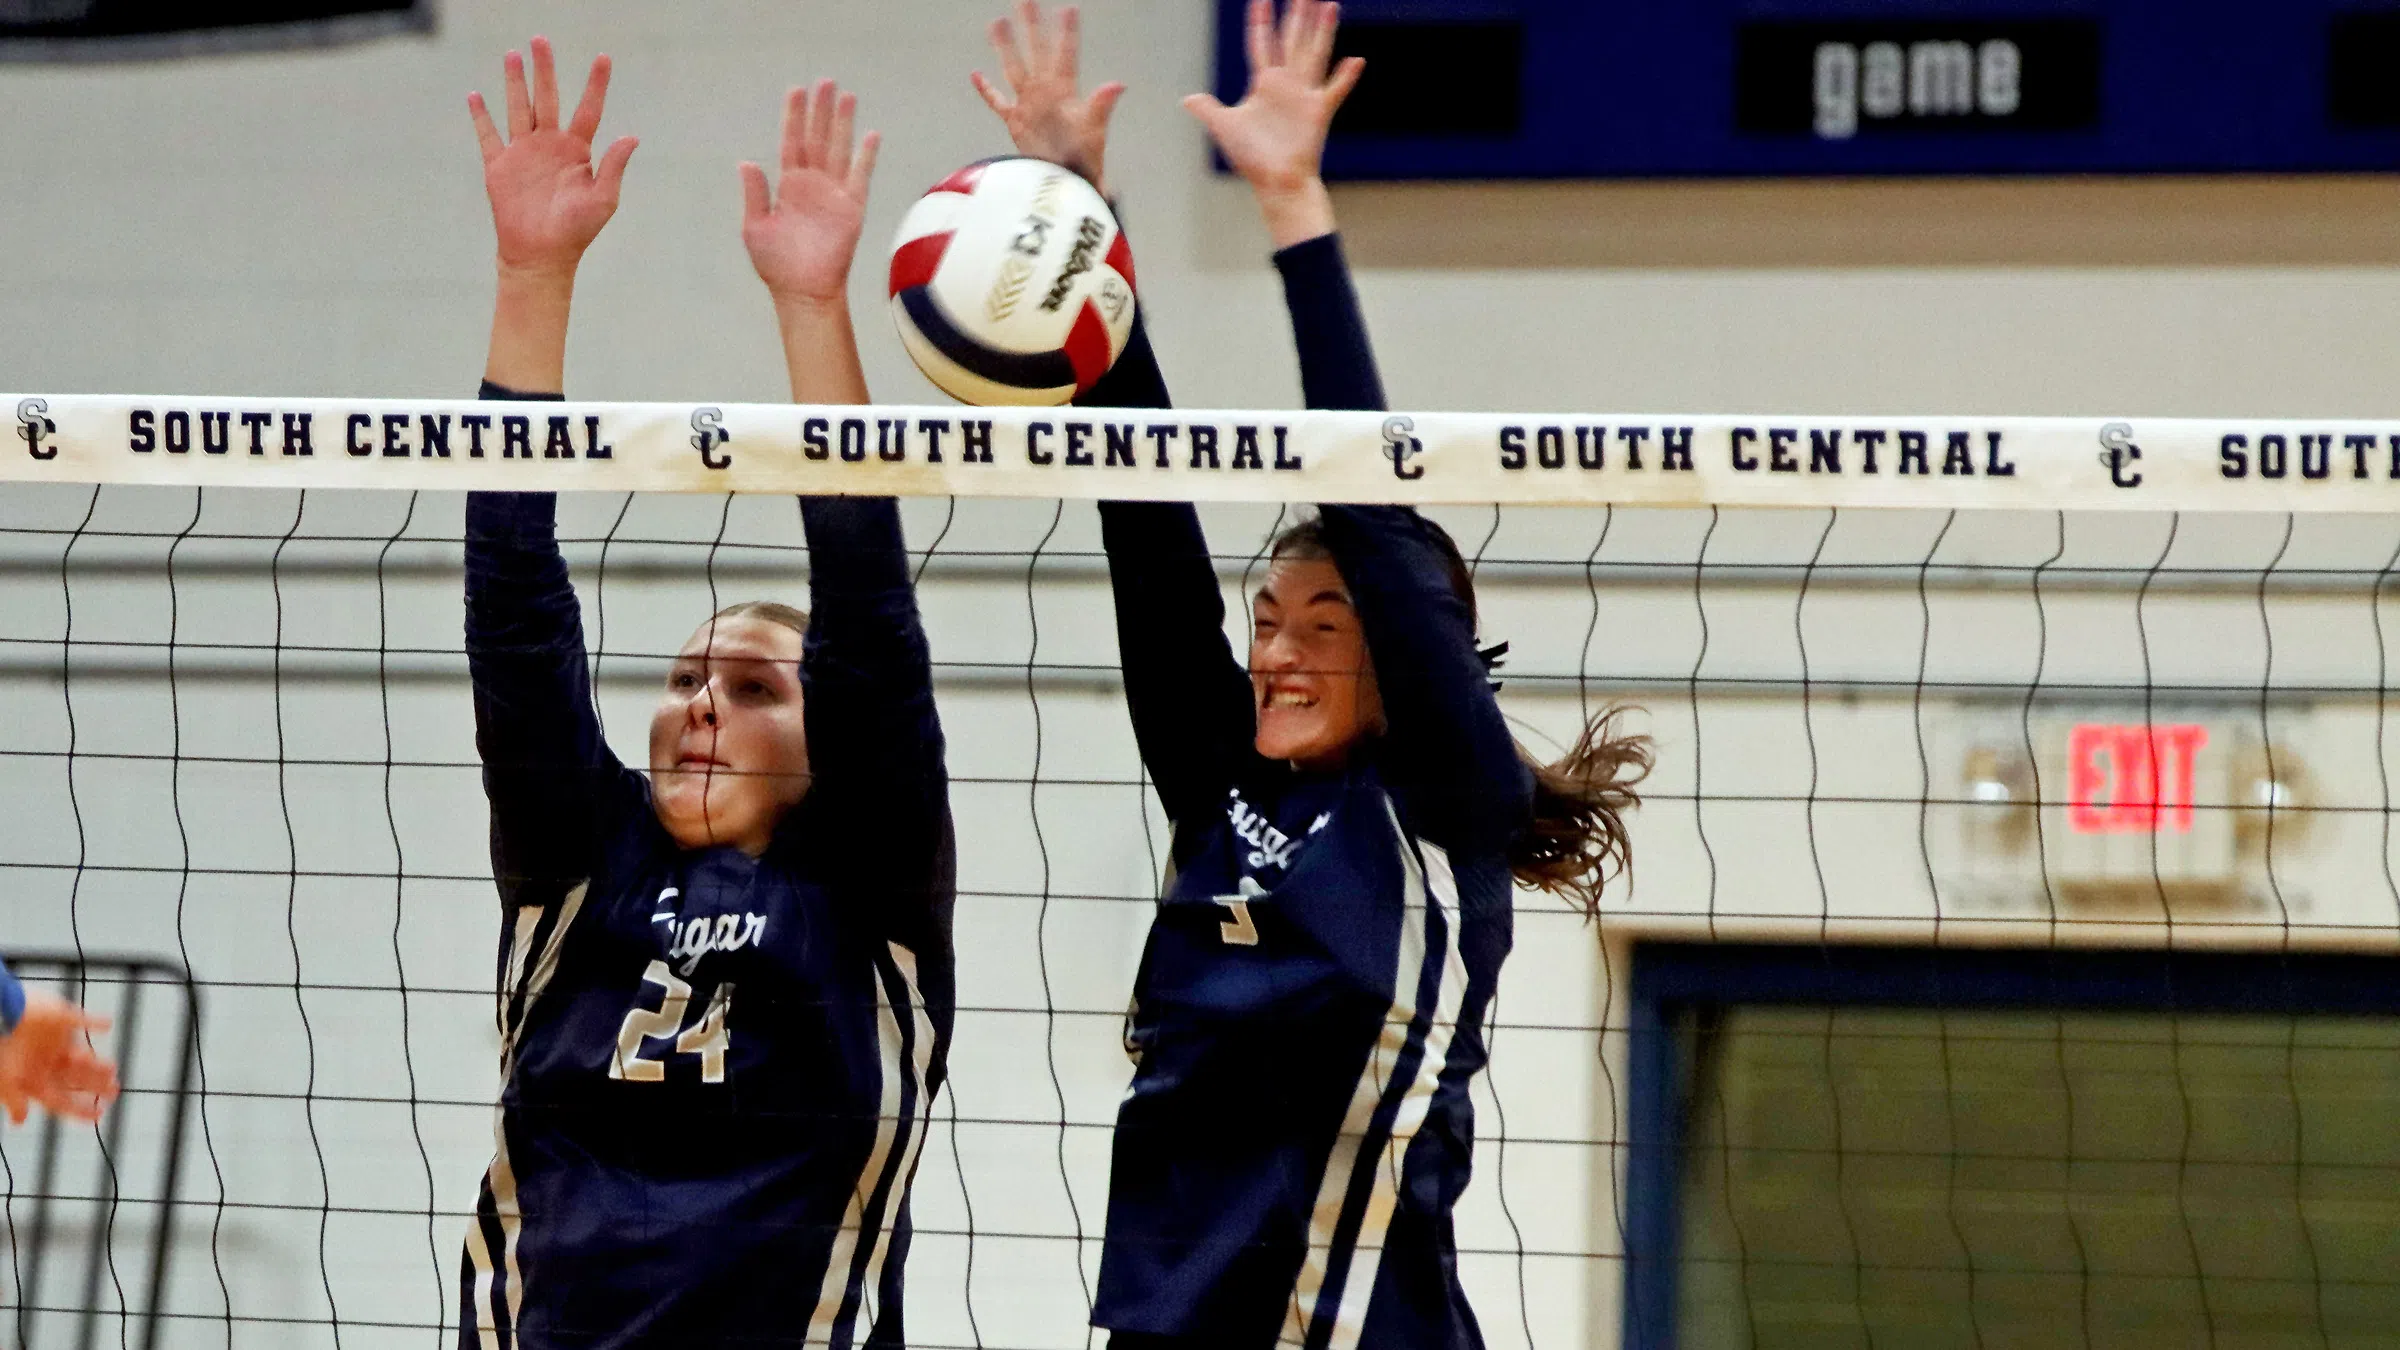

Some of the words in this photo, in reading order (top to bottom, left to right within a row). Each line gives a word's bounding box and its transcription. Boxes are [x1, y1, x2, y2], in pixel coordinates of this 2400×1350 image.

[1813, 38, 2021, 140] game
[1039, 216, 1104, 313] Wilson
[130, 409, 314, 456] SOUTH
[346, 413, 613, 459] CENTRAL
[803, 418, 995, 463] SOUTH
[1027, 421, 1302, 470] CENTRAL
[1500, 426, 1695, 470] SOUTH
[1732, 427, 2016, 476] CENTRAL
[2066, 724, 2208, 834] EXIT
[608, 959, 736, 1083] 24
